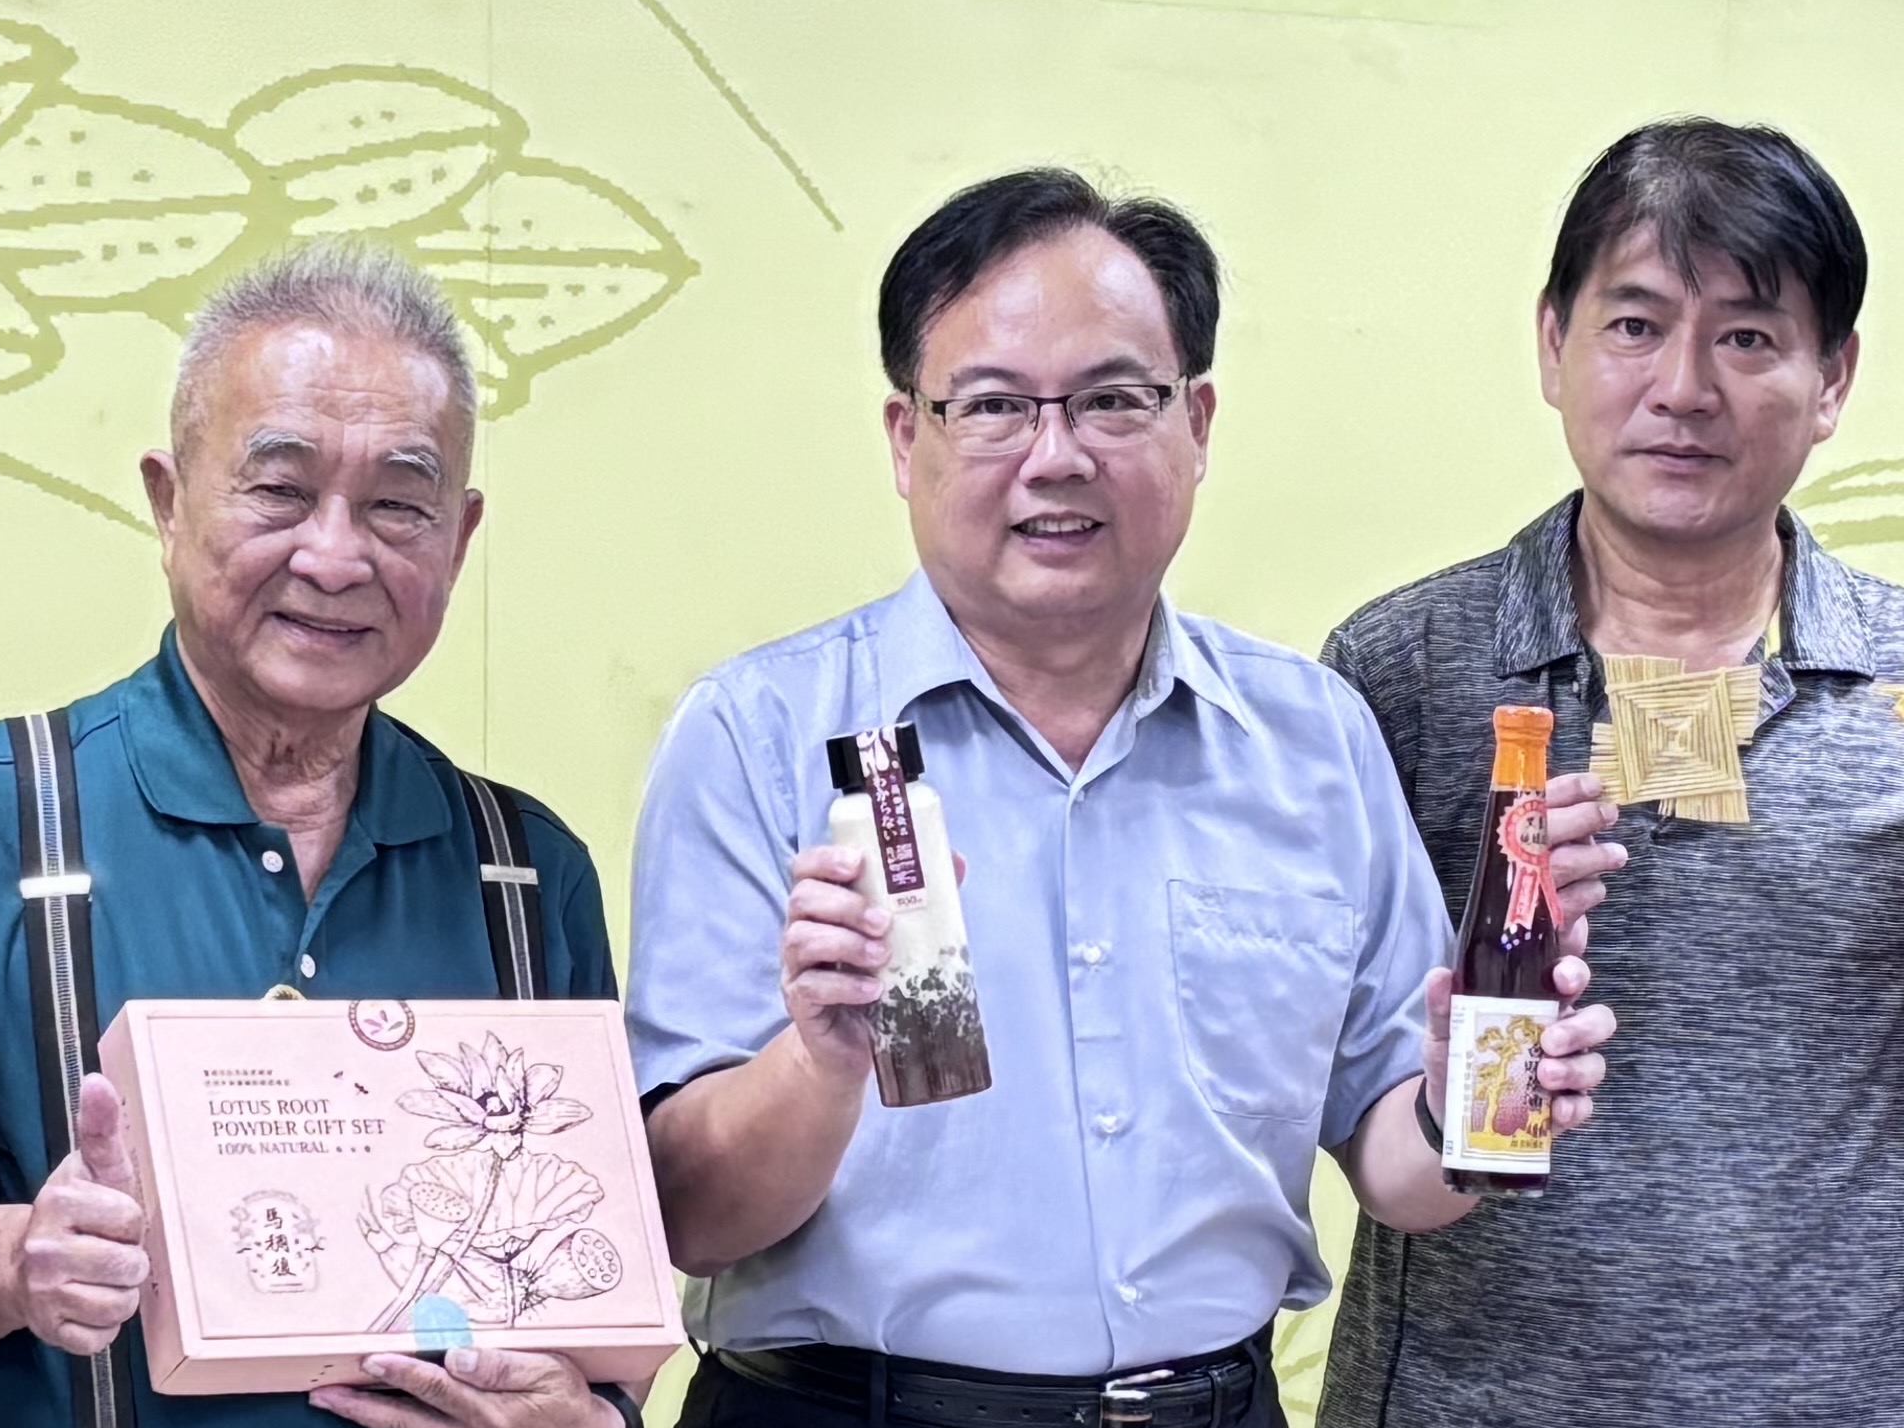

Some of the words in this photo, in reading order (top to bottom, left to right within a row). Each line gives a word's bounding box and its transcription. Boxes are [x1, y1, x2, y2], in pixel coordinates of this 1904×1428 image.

[208, 1099, 271, 1116] LOTUS
[277, 1098, 331, 1115] ROOT
[212, 1120, 297, 1136] POWDER
[303, 1118, 346, 1135] GIFT
[351, 1118, 386, 1135] SET
[259, 1141, 329, 1155] NATURAL
